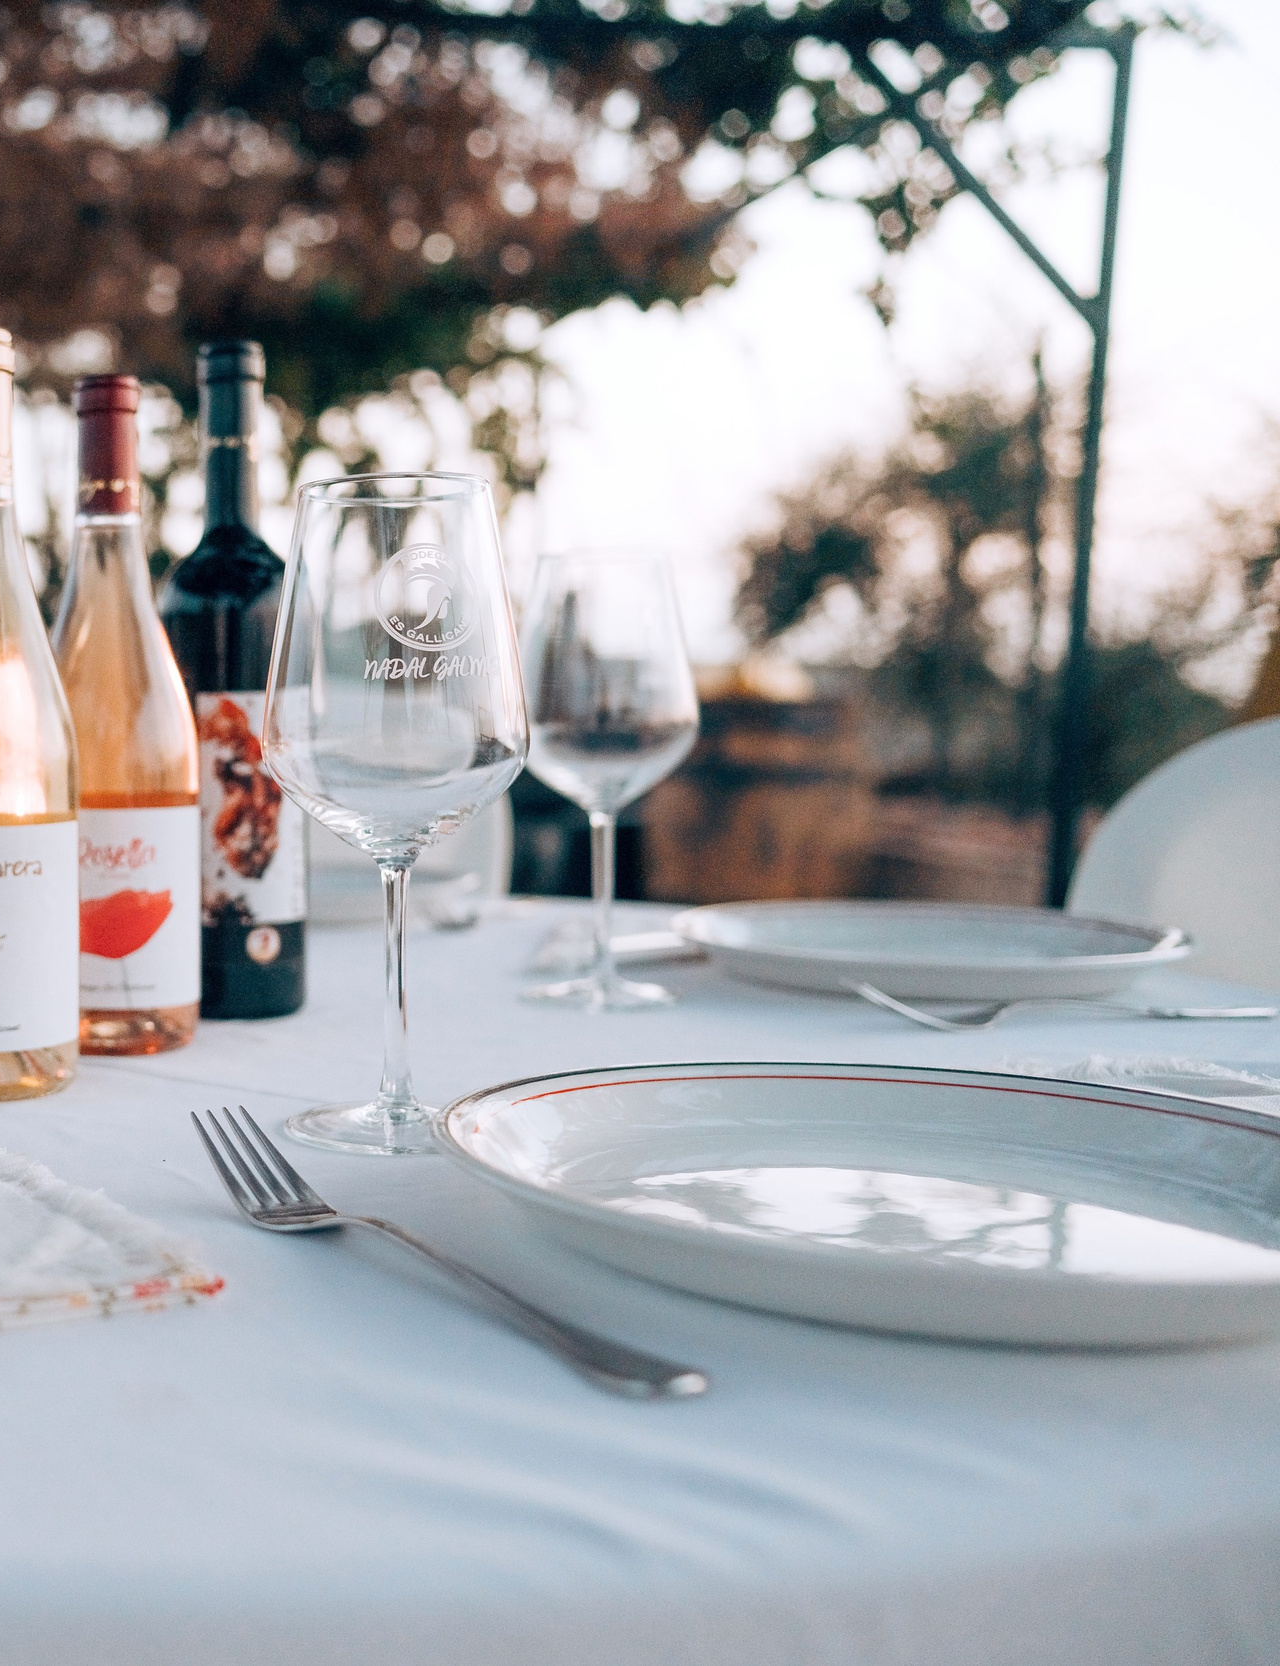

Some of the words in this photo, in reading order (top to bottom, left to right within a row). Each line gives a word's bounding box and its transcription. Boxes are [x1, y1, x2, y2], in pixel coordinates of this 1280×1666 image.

[389, 615, 405, 631] ES
[364, 656, 430, 681] NADAL
[433, 655, 500, 681] GALM
